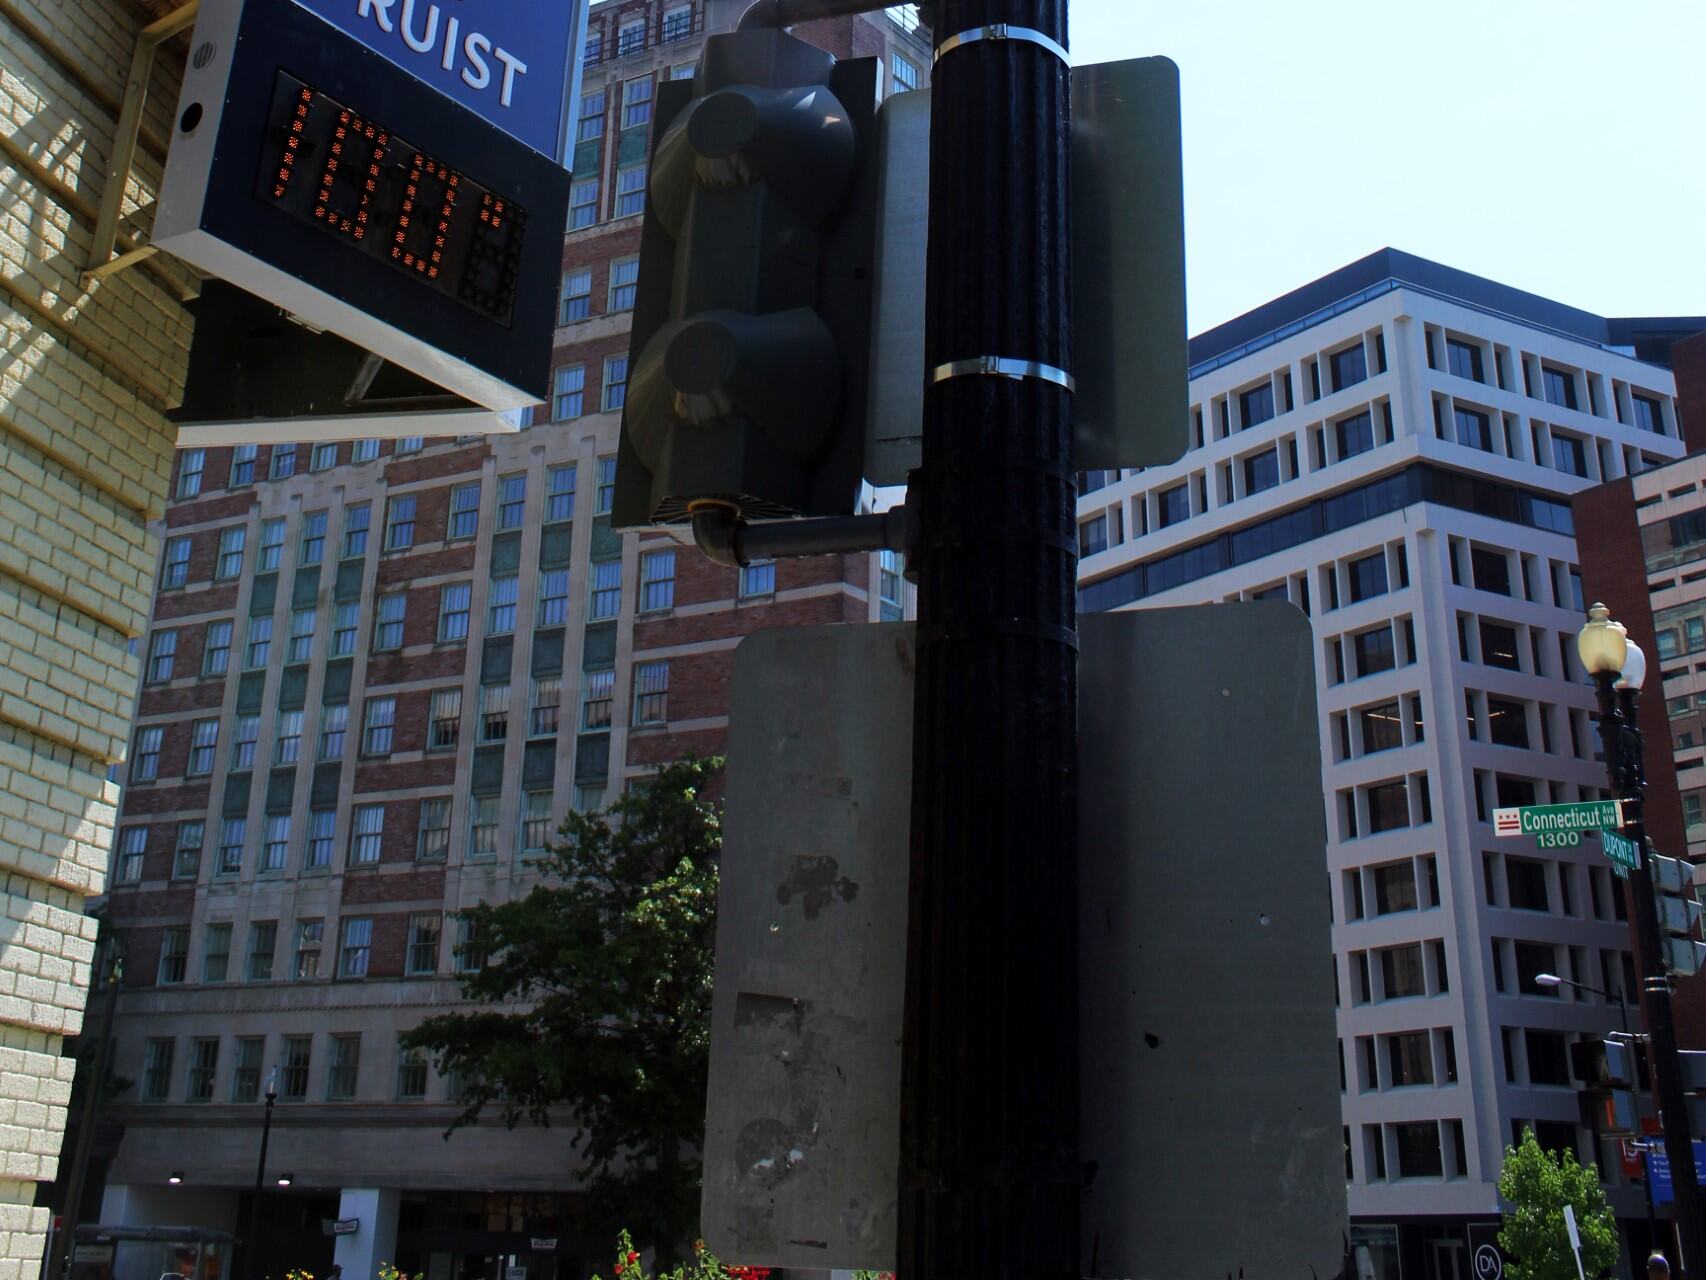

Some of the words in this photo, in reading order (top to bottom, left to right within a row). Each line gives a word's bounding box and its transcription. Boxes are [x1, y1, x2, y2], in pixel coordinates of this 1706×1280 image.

[1523, 806, 1600, 831] Connecticut
[1602, 805, 1615, 815] Ave
[1603, 814, 1616, 825] NW
[1537, 831, 1579, 848] 1300
[1603, 831, 1628, 861] DUPONT
